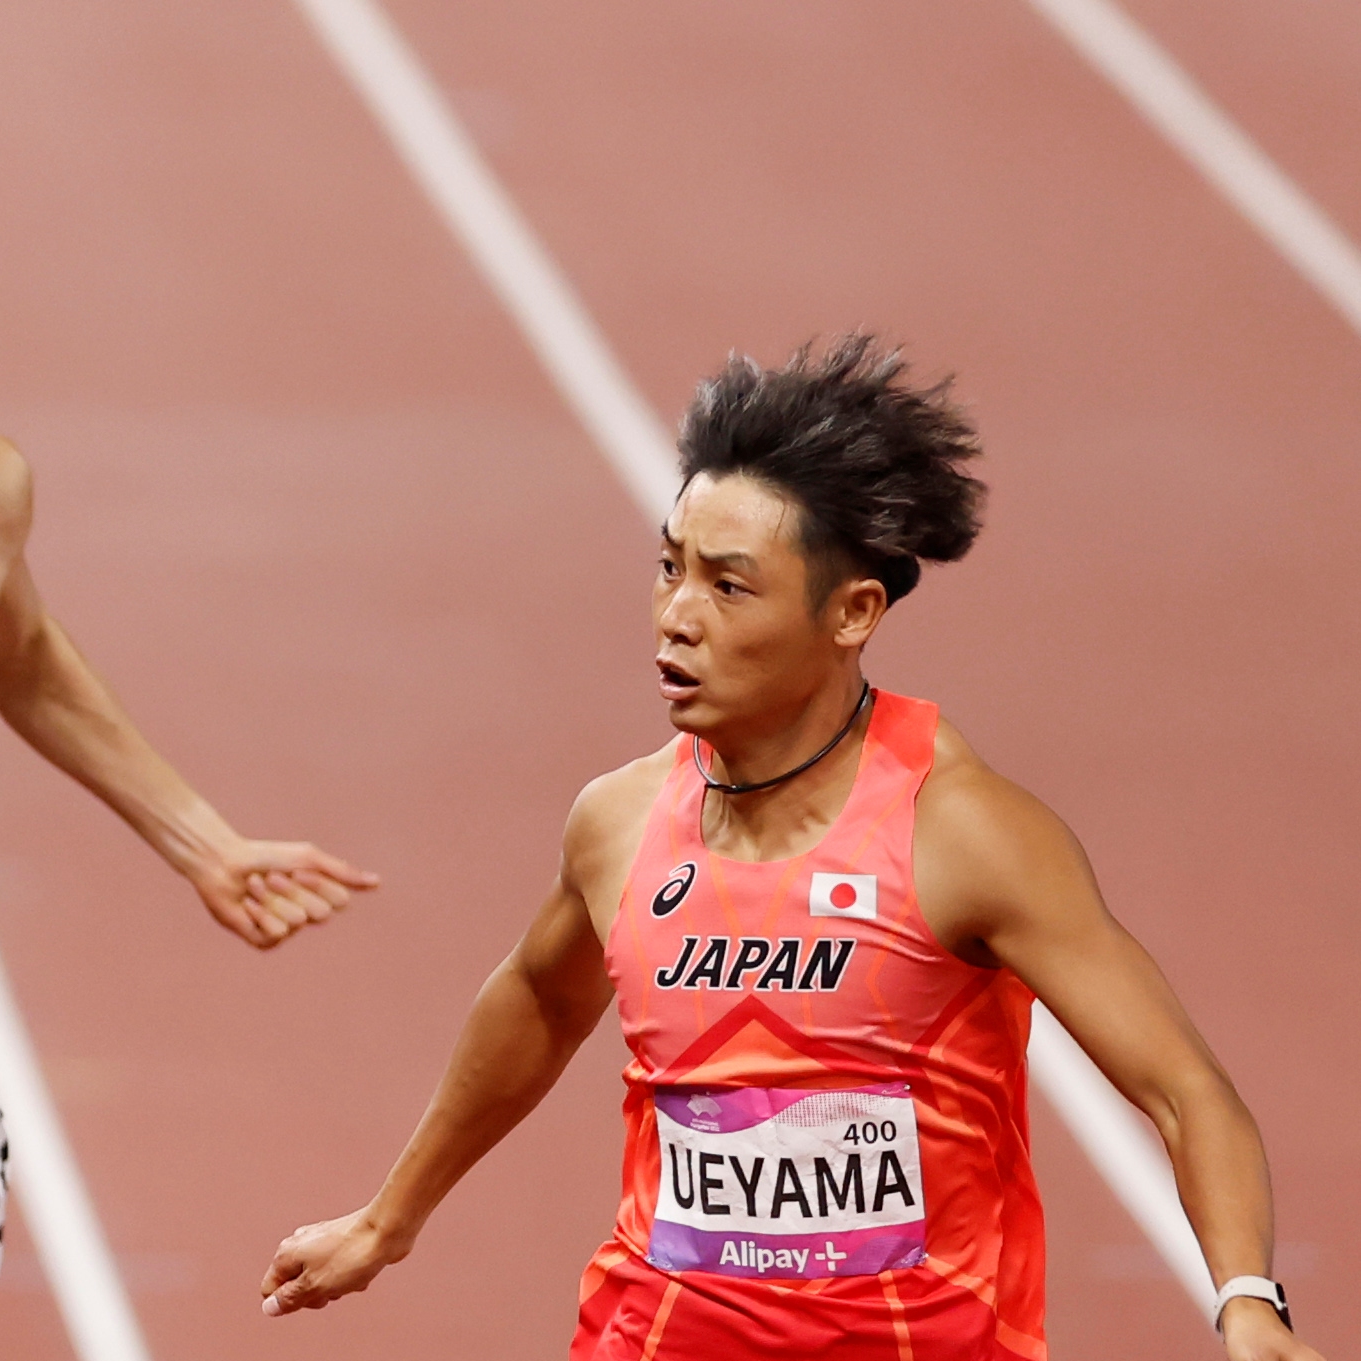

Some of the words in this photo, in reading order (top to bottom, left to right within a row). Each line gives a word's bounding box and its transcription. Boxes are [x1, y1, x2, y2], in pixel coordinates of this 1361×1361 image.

[654, 934, 858, 992] JAPAN
[843, 1119, 898, 1146] 400
[668, 1143, 916, 1219] UEYAMA
